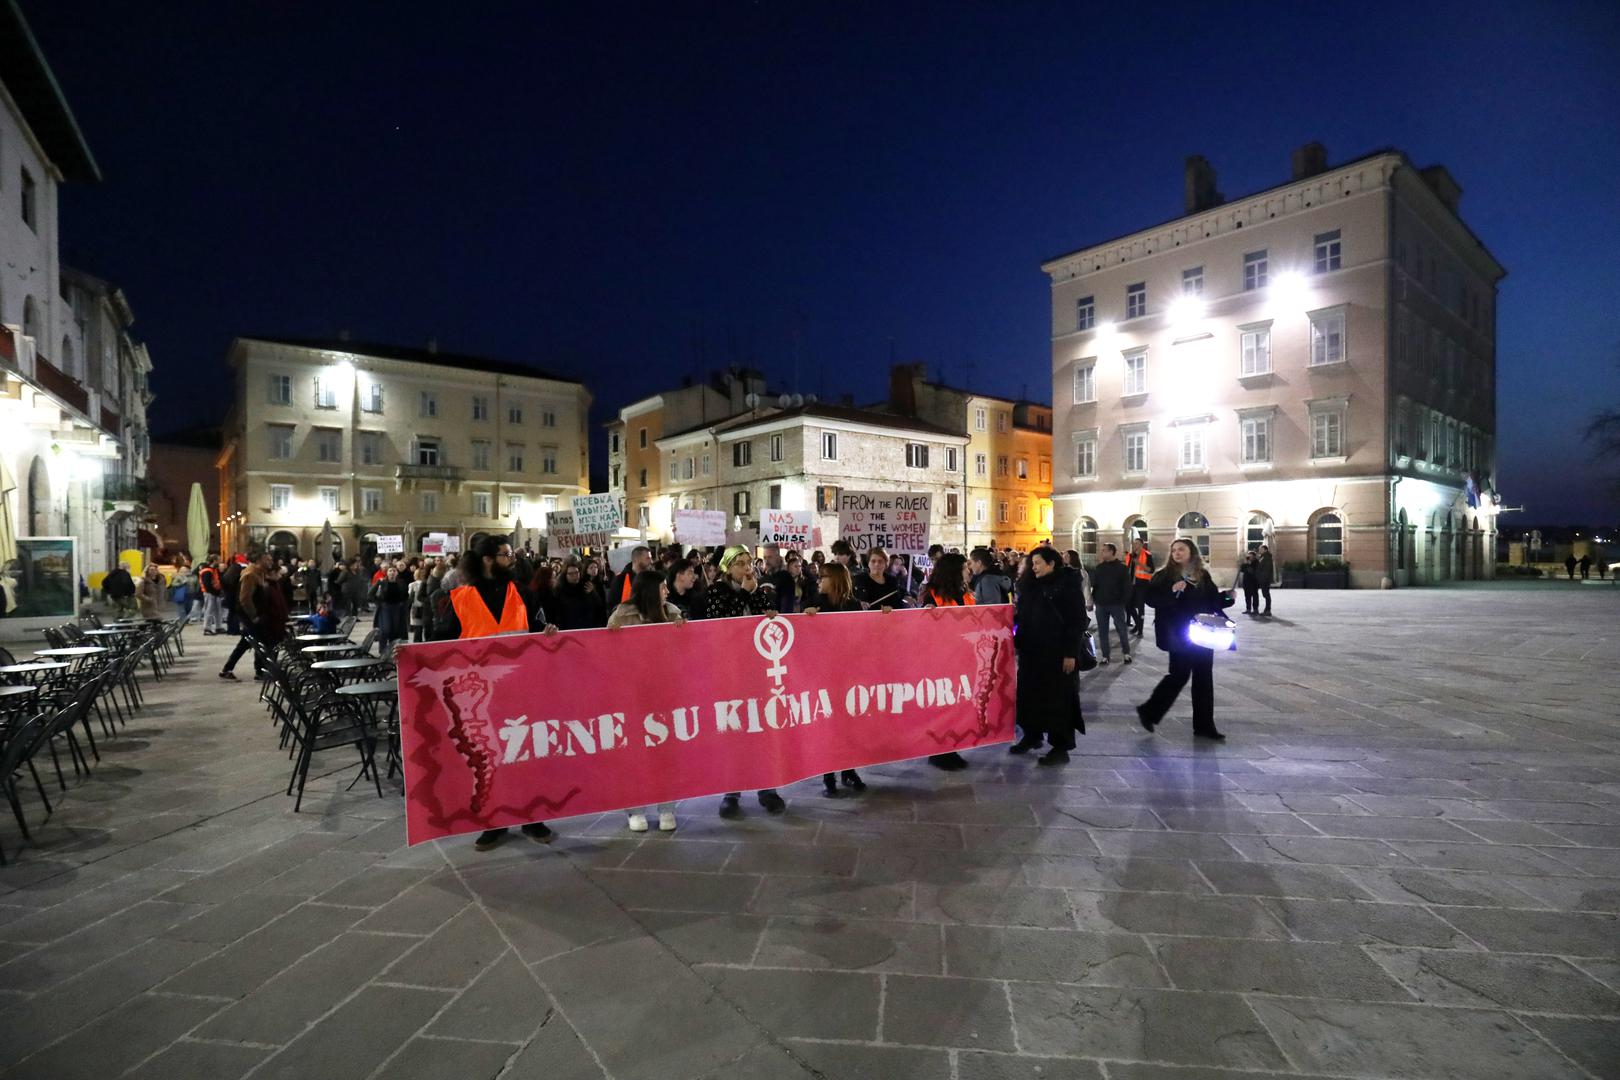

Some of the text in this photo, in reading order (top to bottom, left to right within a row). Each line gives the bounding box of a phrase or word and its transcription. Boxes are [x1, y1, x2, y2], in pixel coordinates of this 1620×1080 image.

[842, 495, 928, 510] FROM THE RIVER
[576, 504, 616, 516] RADNICA
[851, 511, 917, 521] TO THE SEA
[560, 516, 574, 524] nos
[579, 512, 619, 524] NIJE NAM
[769, 512, 793, 524] NAS
[579, 521, 617, 533] STRANA
[774, 524, 808, 534] DIJELE
[843, 522, 926, 533] ALL THE WOMEN
[557, 532, 606, 548] REVOLUCIJU
[763, 534, 770, 543] A
[842, 533, 925, 550] MUST BE FREE
[498, 674, 972, 765] ŽENE SU KIČMA OTPORA
